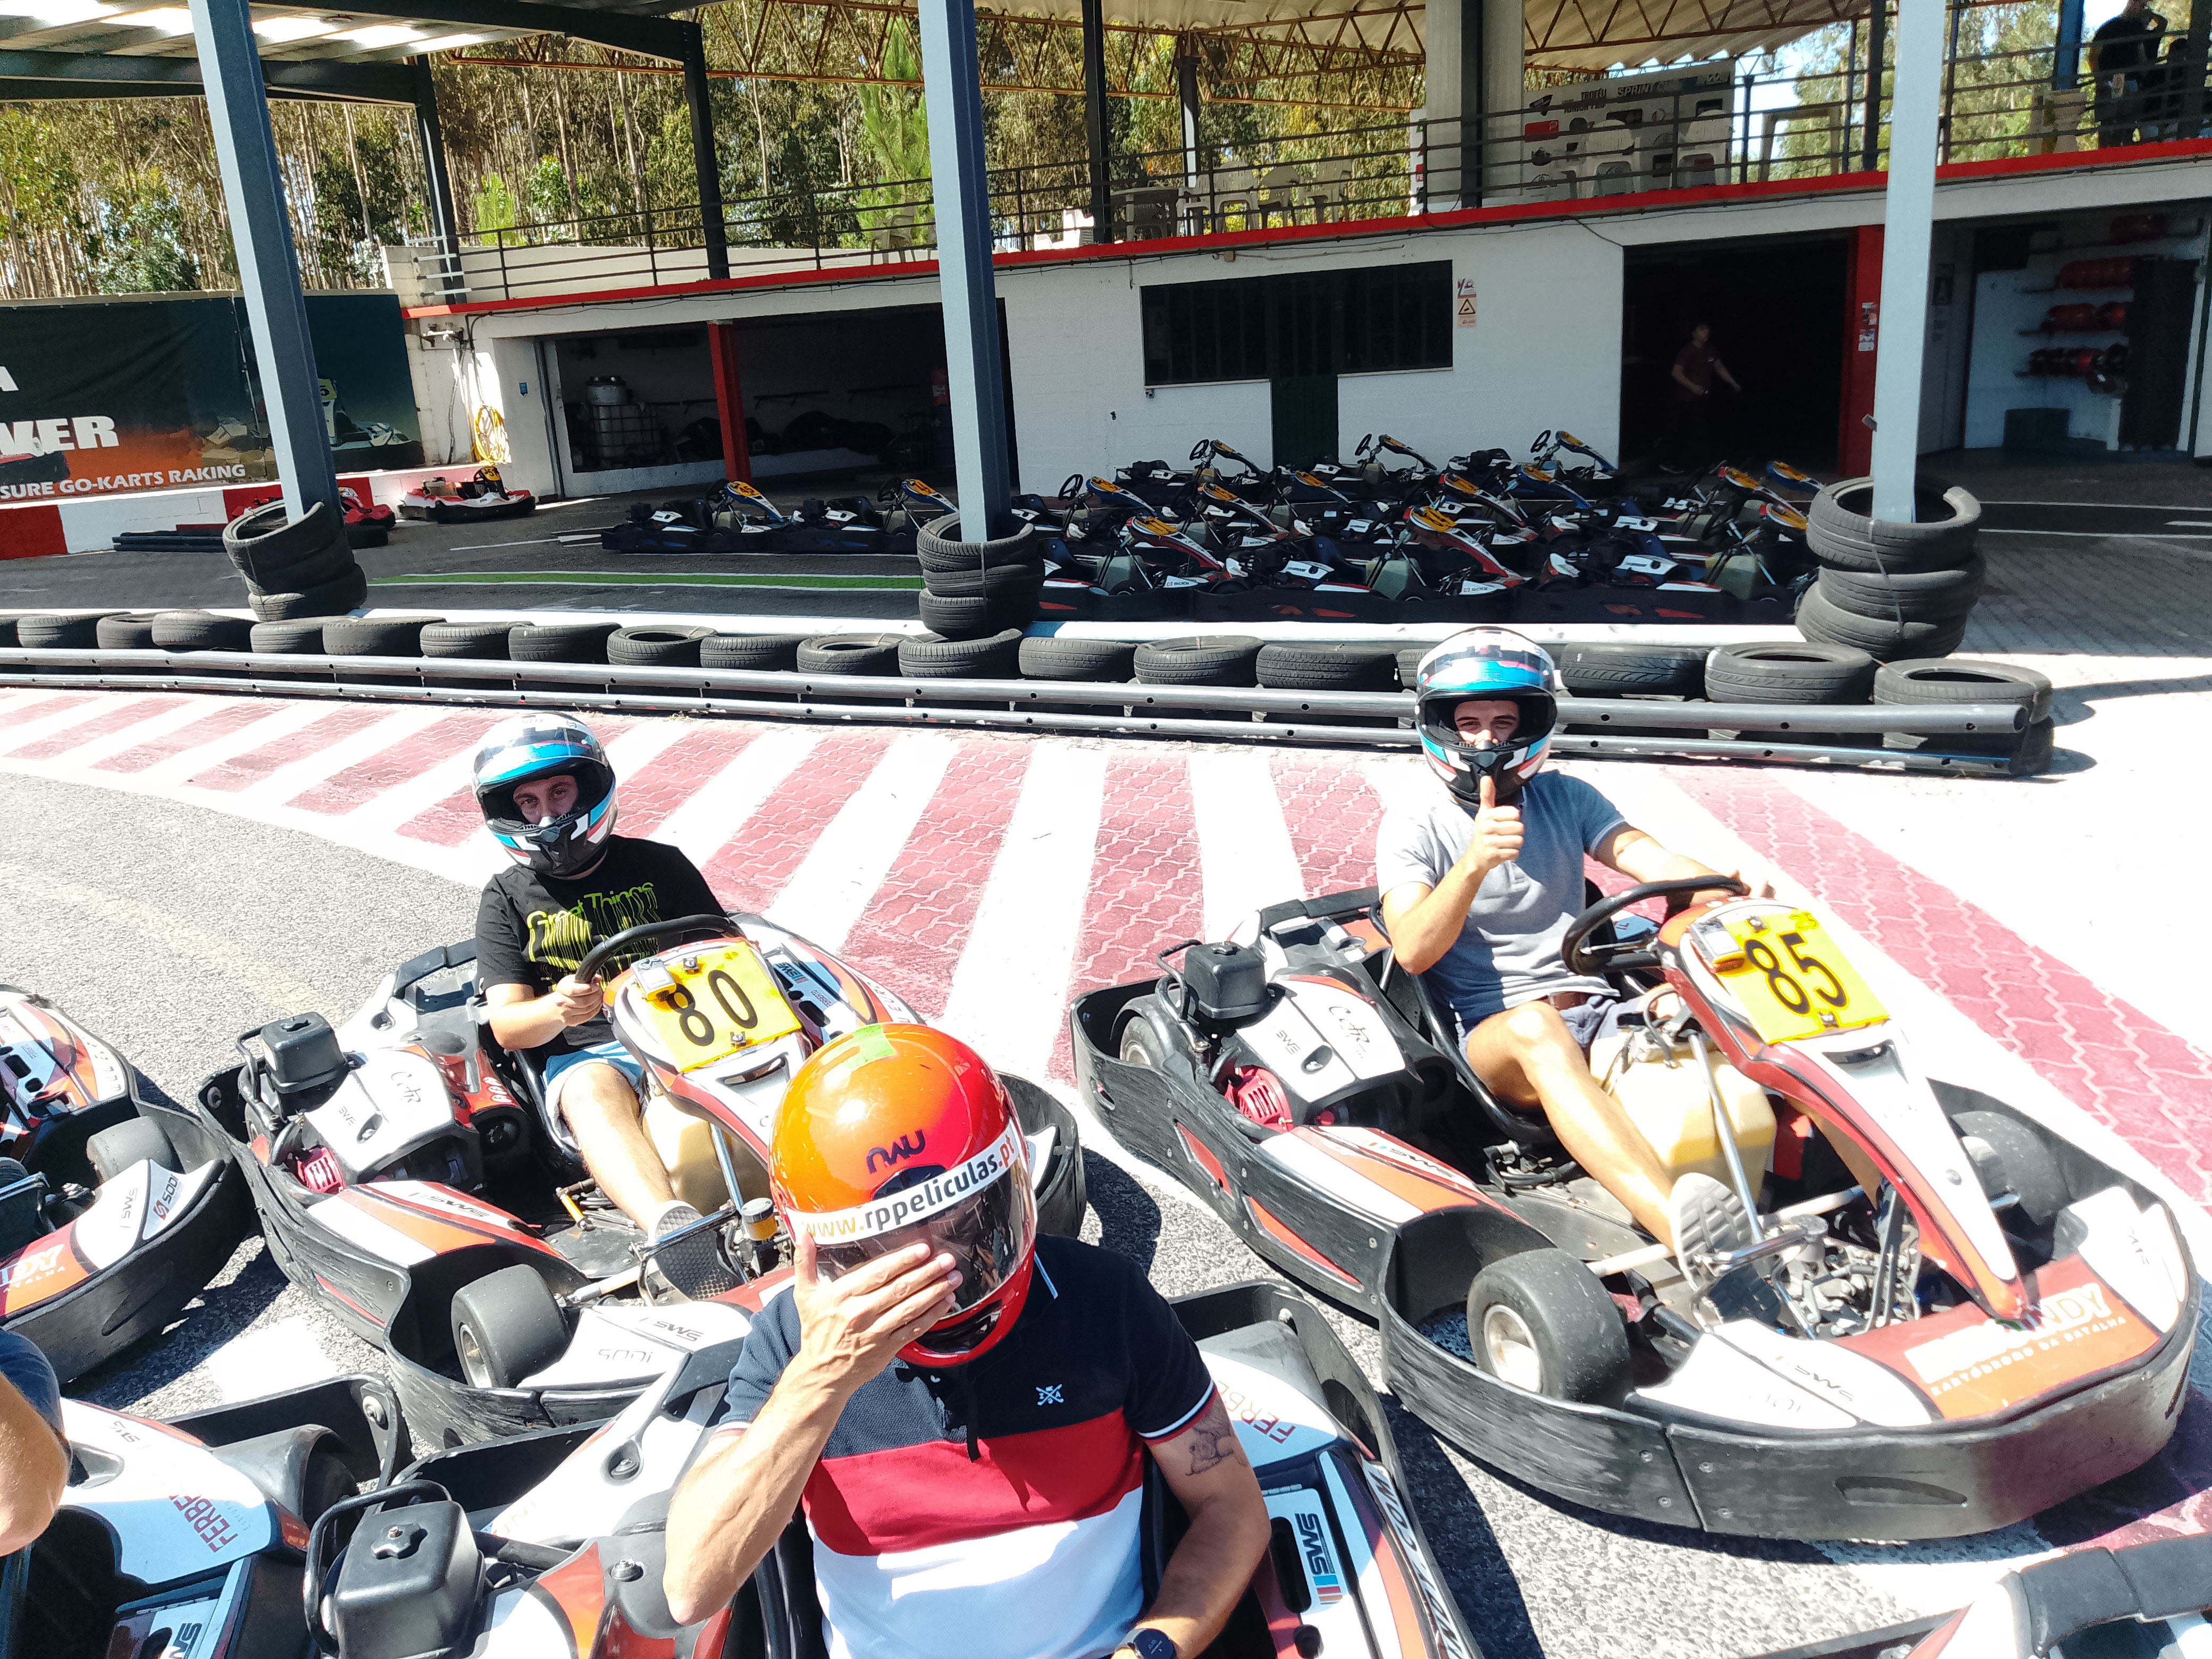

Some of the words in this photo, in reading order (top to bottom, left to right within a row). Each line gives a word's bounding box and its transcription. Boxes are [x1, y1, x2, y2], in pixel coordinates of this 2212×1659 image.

[59, 471, 163, 495] GO-KARTS
[167, 464, 246, 483] RAKING
[1745, 932, 1847, 1015] 85
[667, 970, 758, 1046] 80
[653, 1321, 704, 1342] SWS
[1294, 1512, 1336, 1575] SWS
